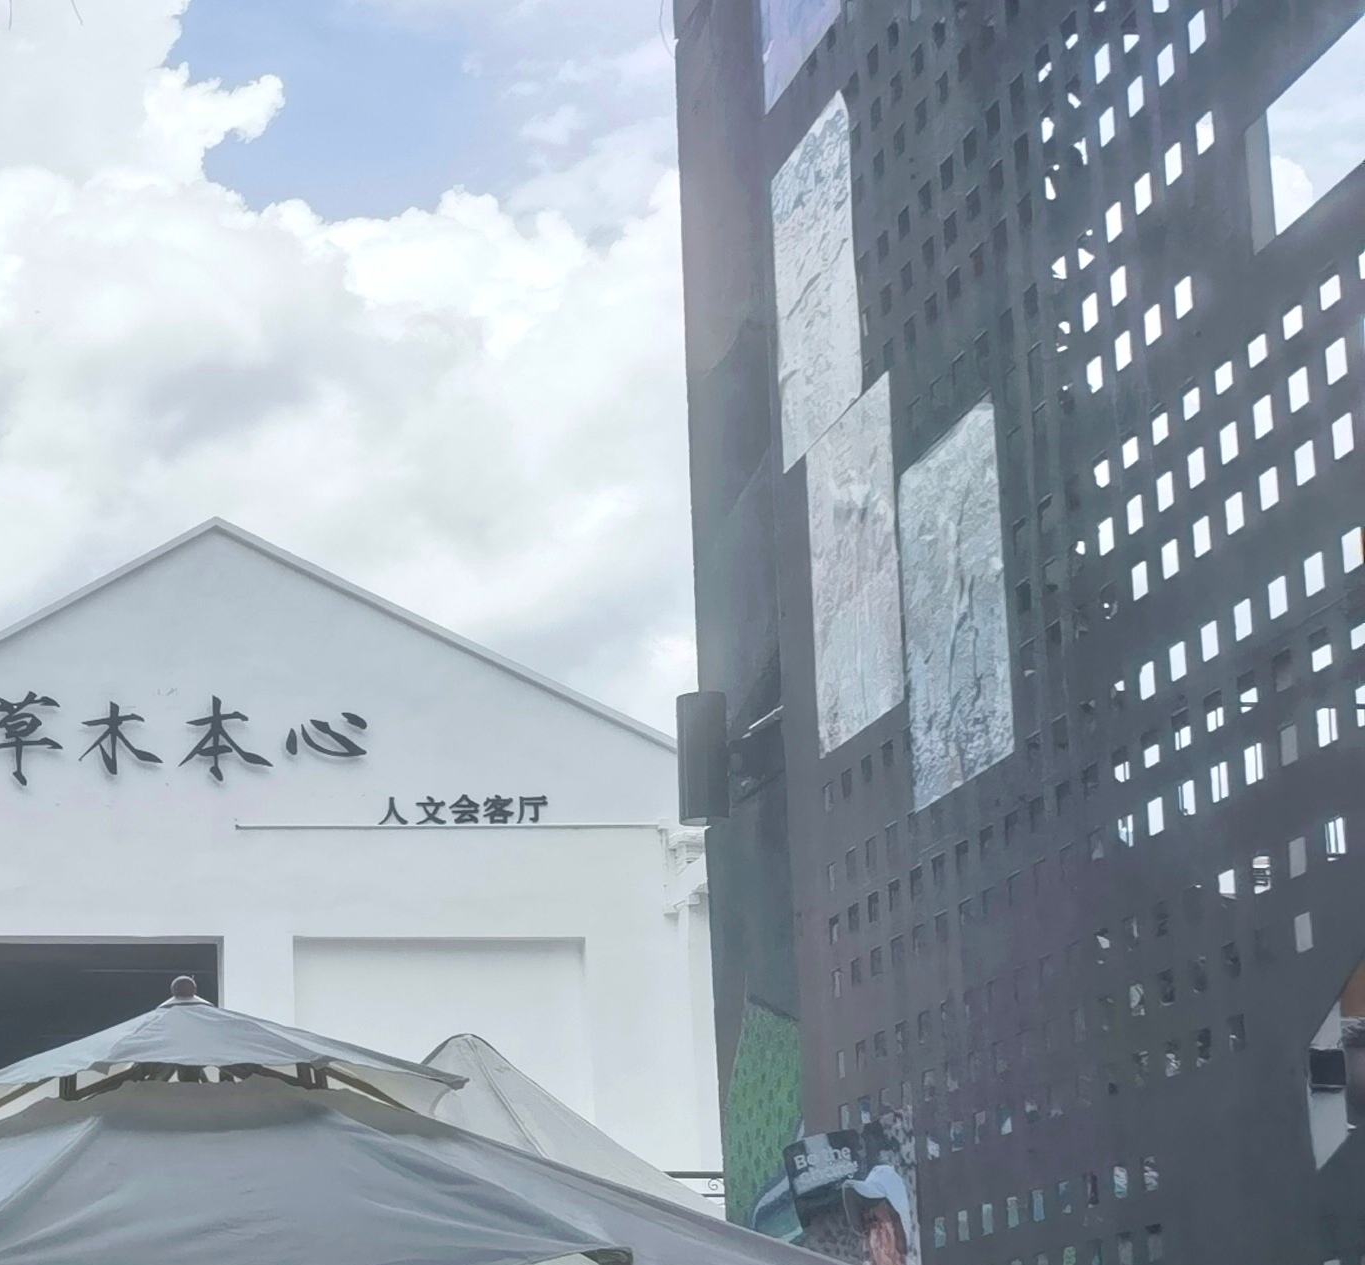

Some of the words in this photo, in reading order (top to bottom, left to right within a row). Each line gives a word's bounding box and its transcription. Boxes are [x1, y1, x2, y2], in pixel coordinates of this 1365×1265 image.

[377, 793, 548, 825] 人文会客厅
